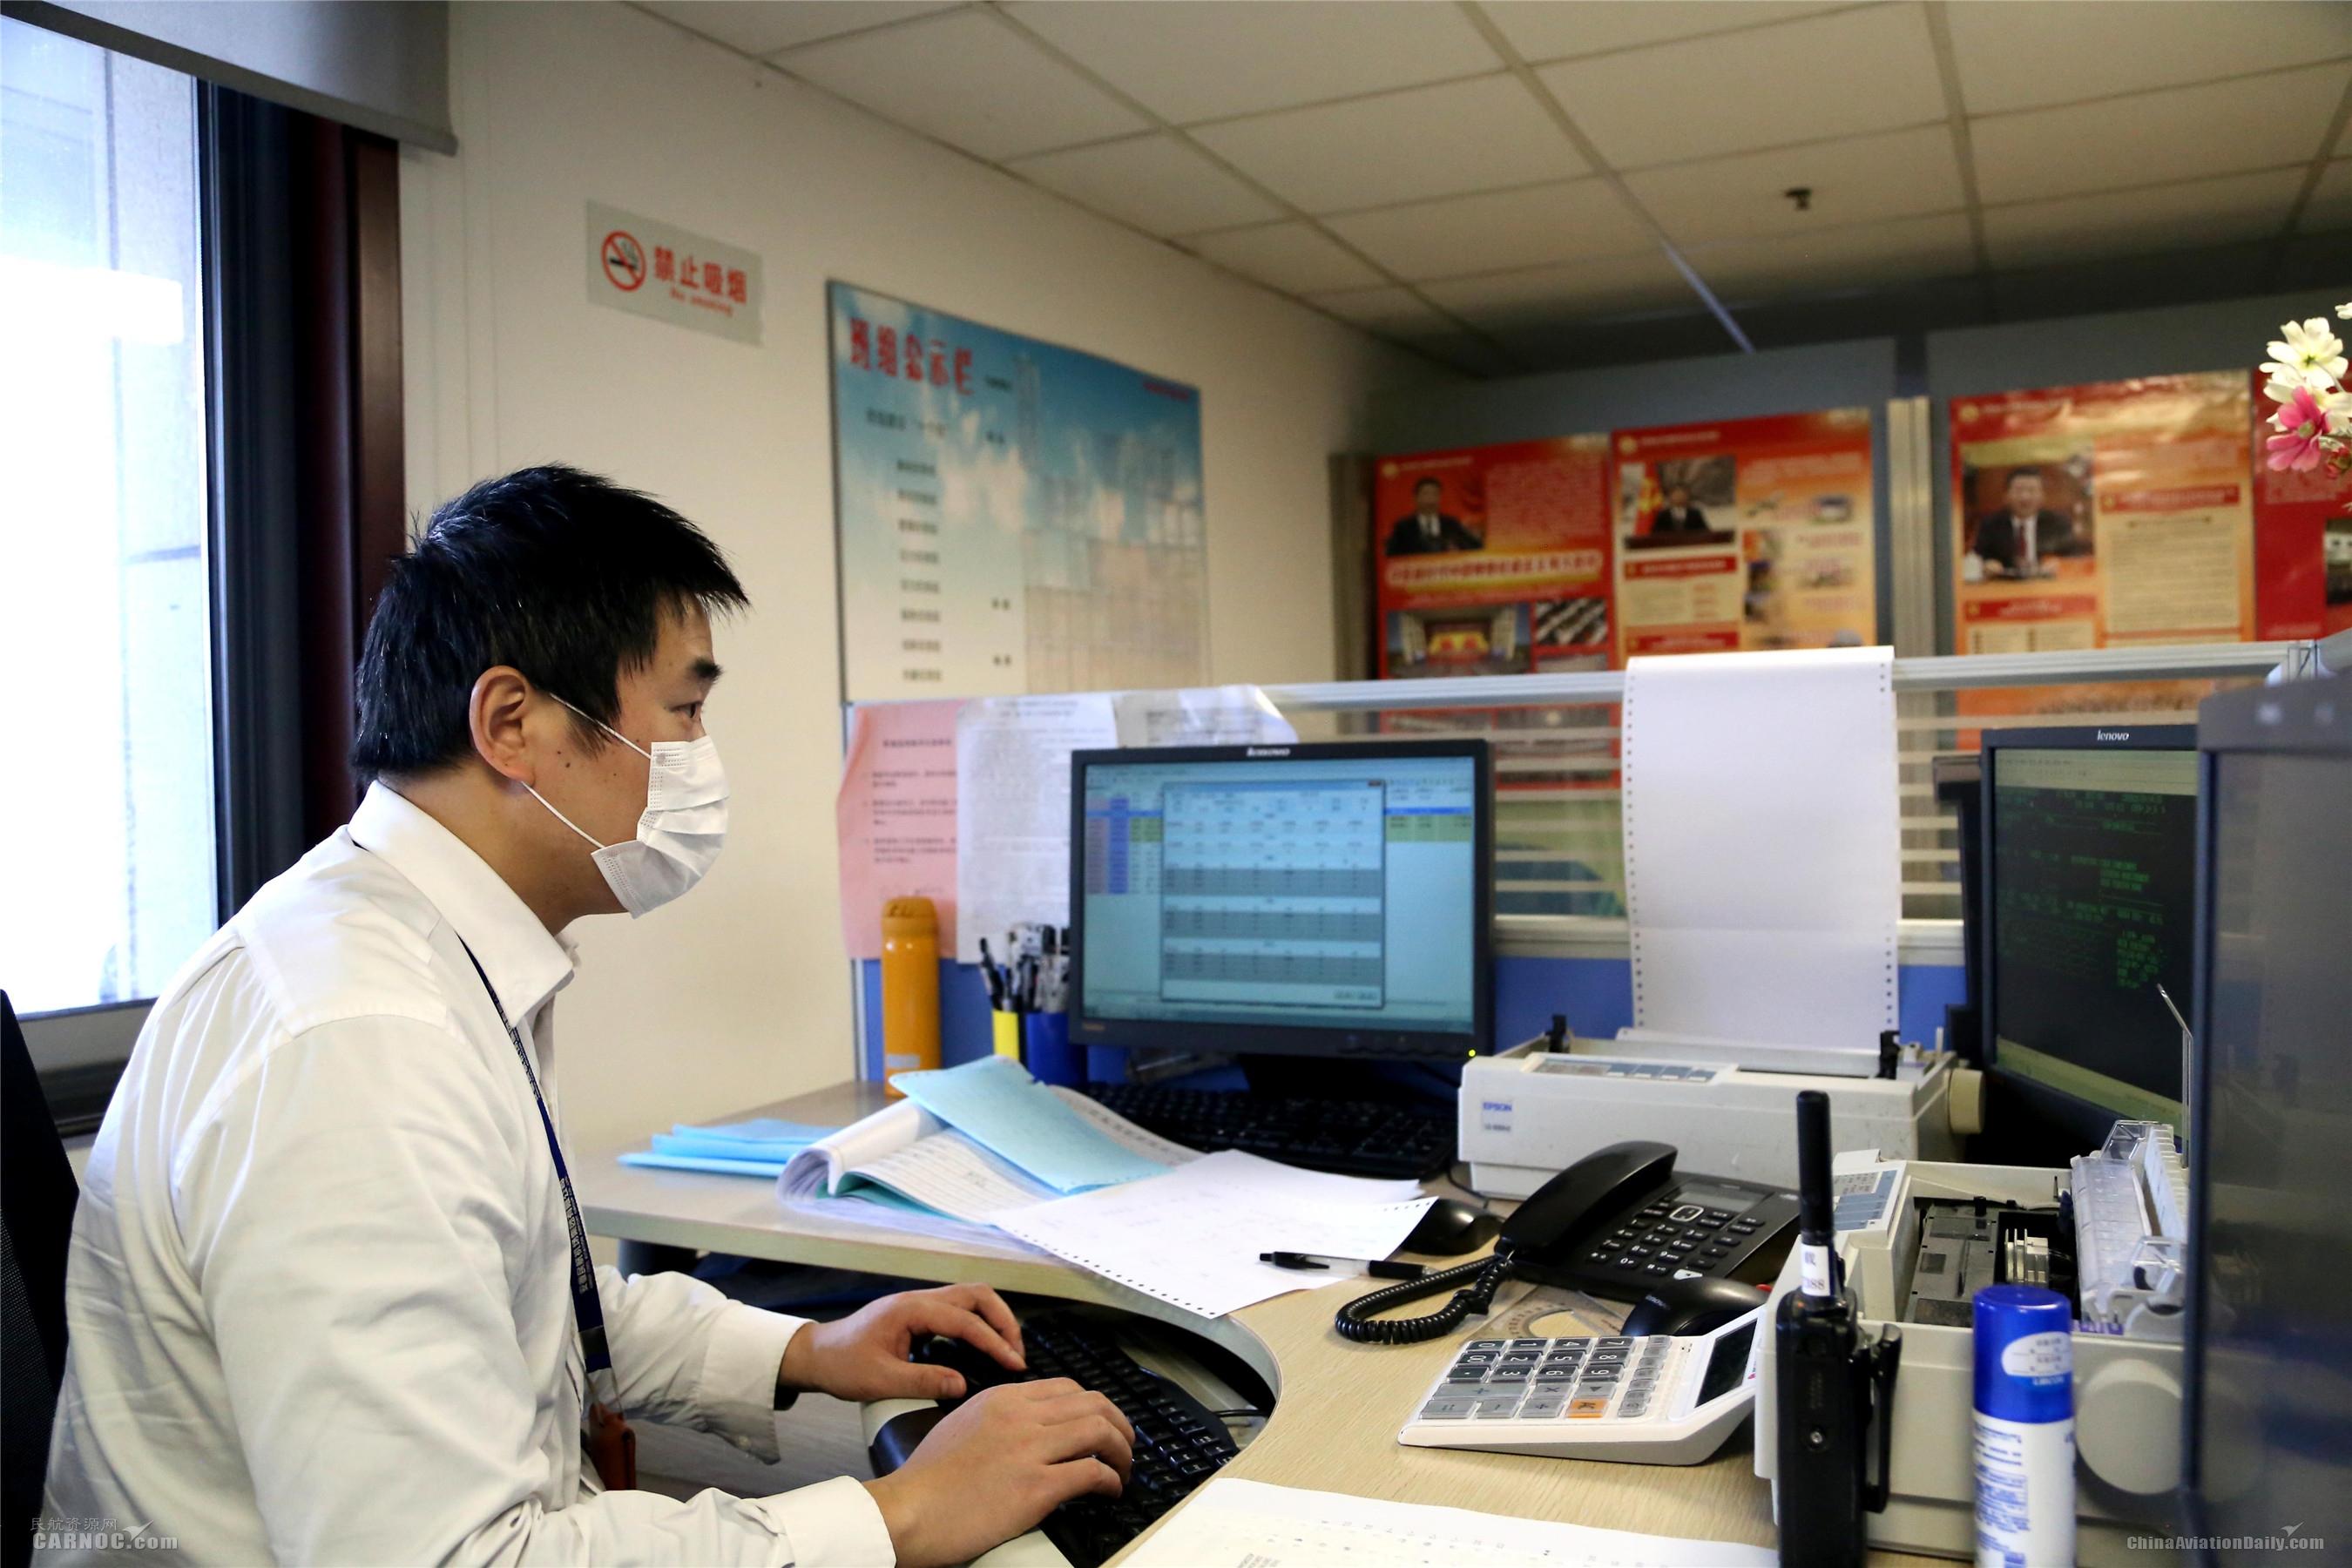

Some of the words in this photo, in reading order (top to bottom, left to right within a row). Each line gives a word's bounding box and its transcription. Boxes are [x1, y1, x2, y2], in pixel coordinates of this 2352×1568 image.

[654, 247, 747, 305] 禁止吸烟
[2097, 729, 2130, 741] lenovo
[1467, 1355, 1487, 1363] 00
